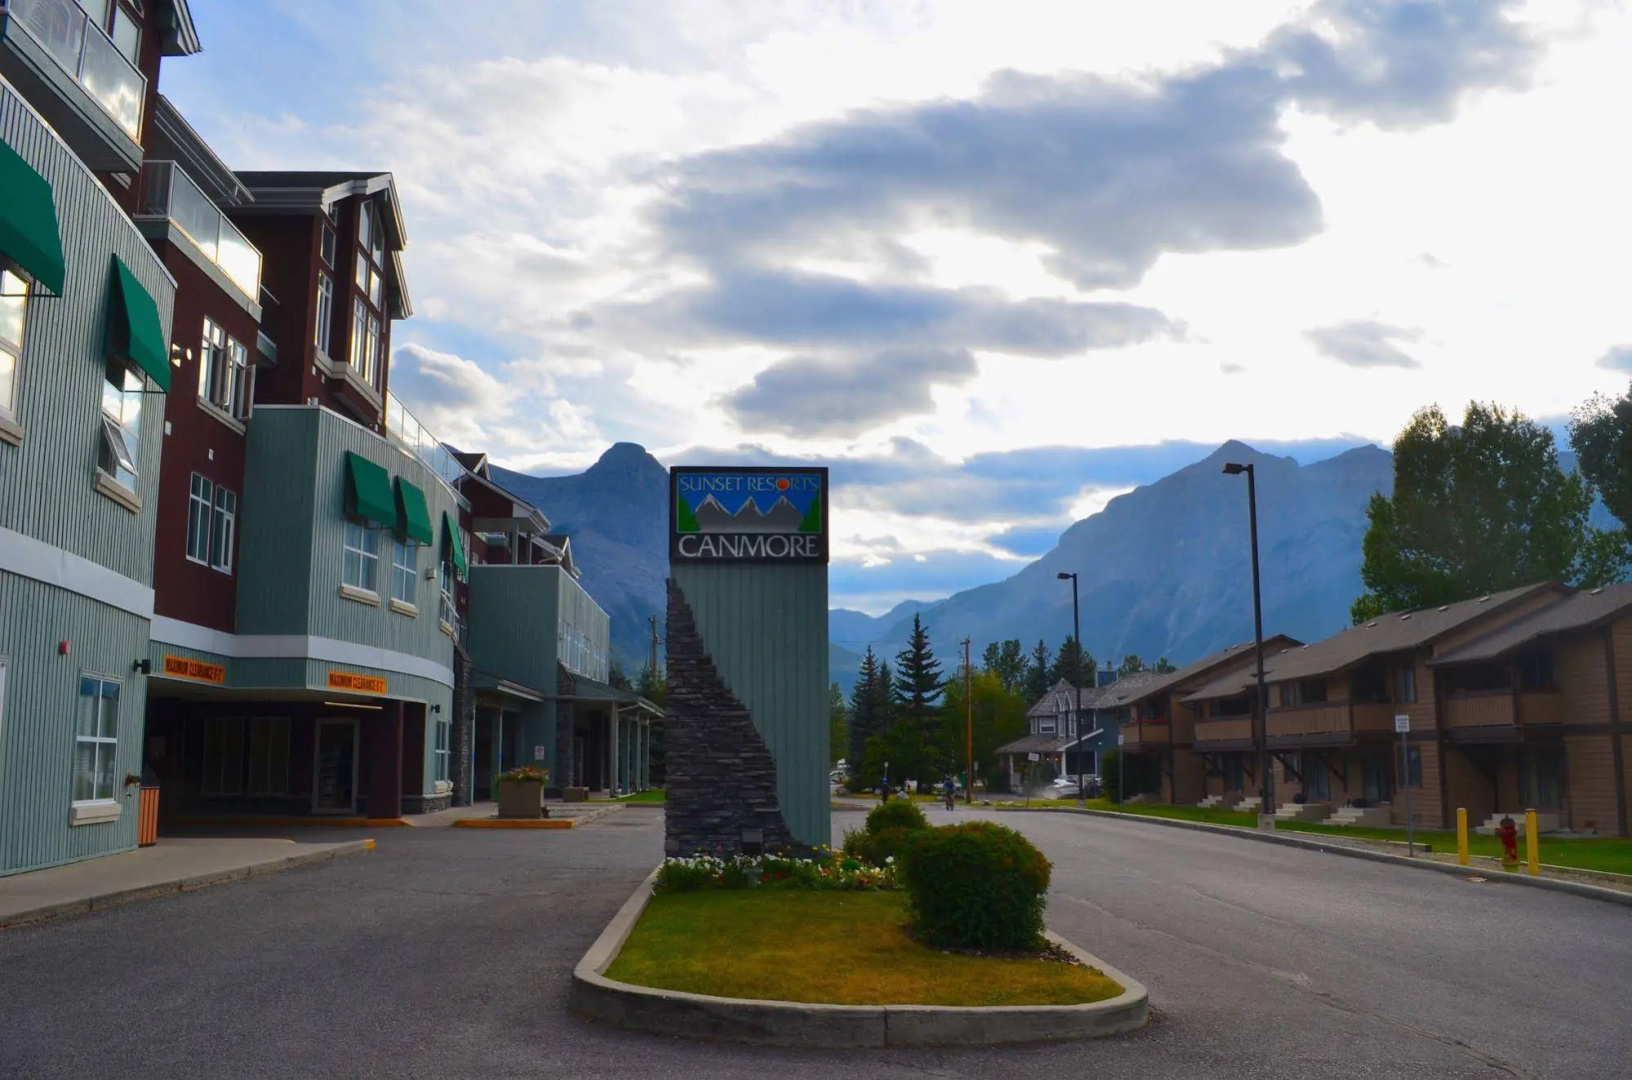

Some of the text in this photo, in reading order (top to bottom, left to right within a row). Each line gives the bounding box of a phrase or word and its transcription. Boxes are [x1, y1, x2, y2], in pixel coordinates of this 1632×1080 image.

[680, 476, 818, 491] SUNSET RESORTS
[678, 535, 819, 557] CANMORE
